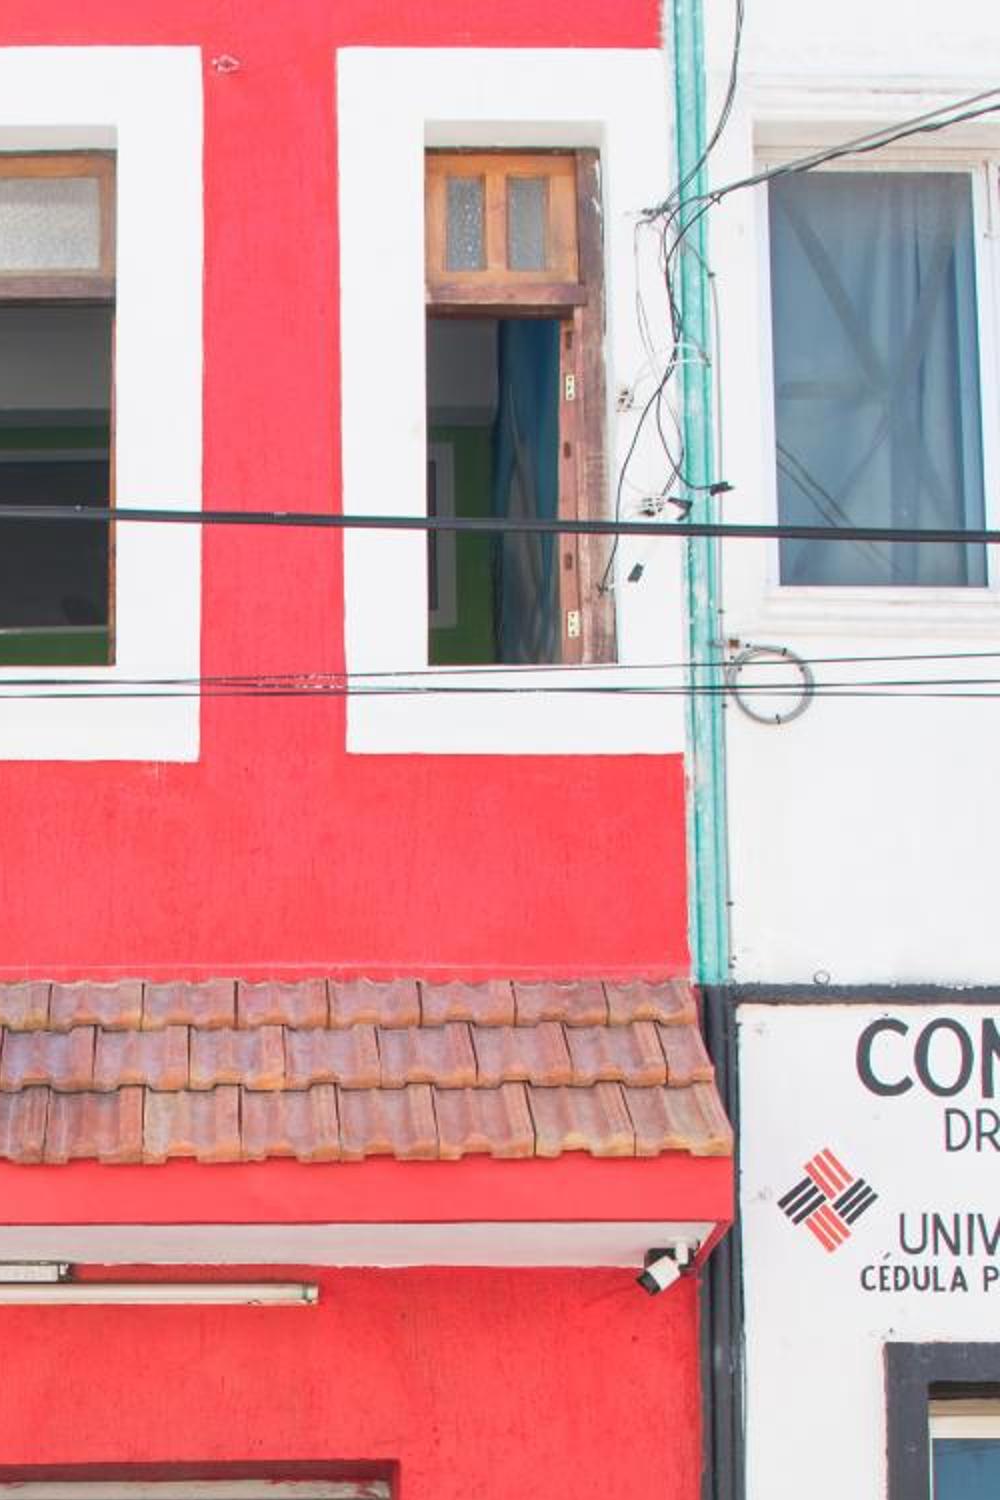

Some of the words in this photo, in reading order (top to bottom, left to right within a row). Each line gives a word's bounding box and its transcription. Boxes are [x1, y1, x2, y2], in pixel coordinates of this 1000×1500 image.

[899, 1212, 1000, 1256] UNIV
[860, 1252, 968, 1292] CÉDULA
[983, 1265, 1000, 1292] P
